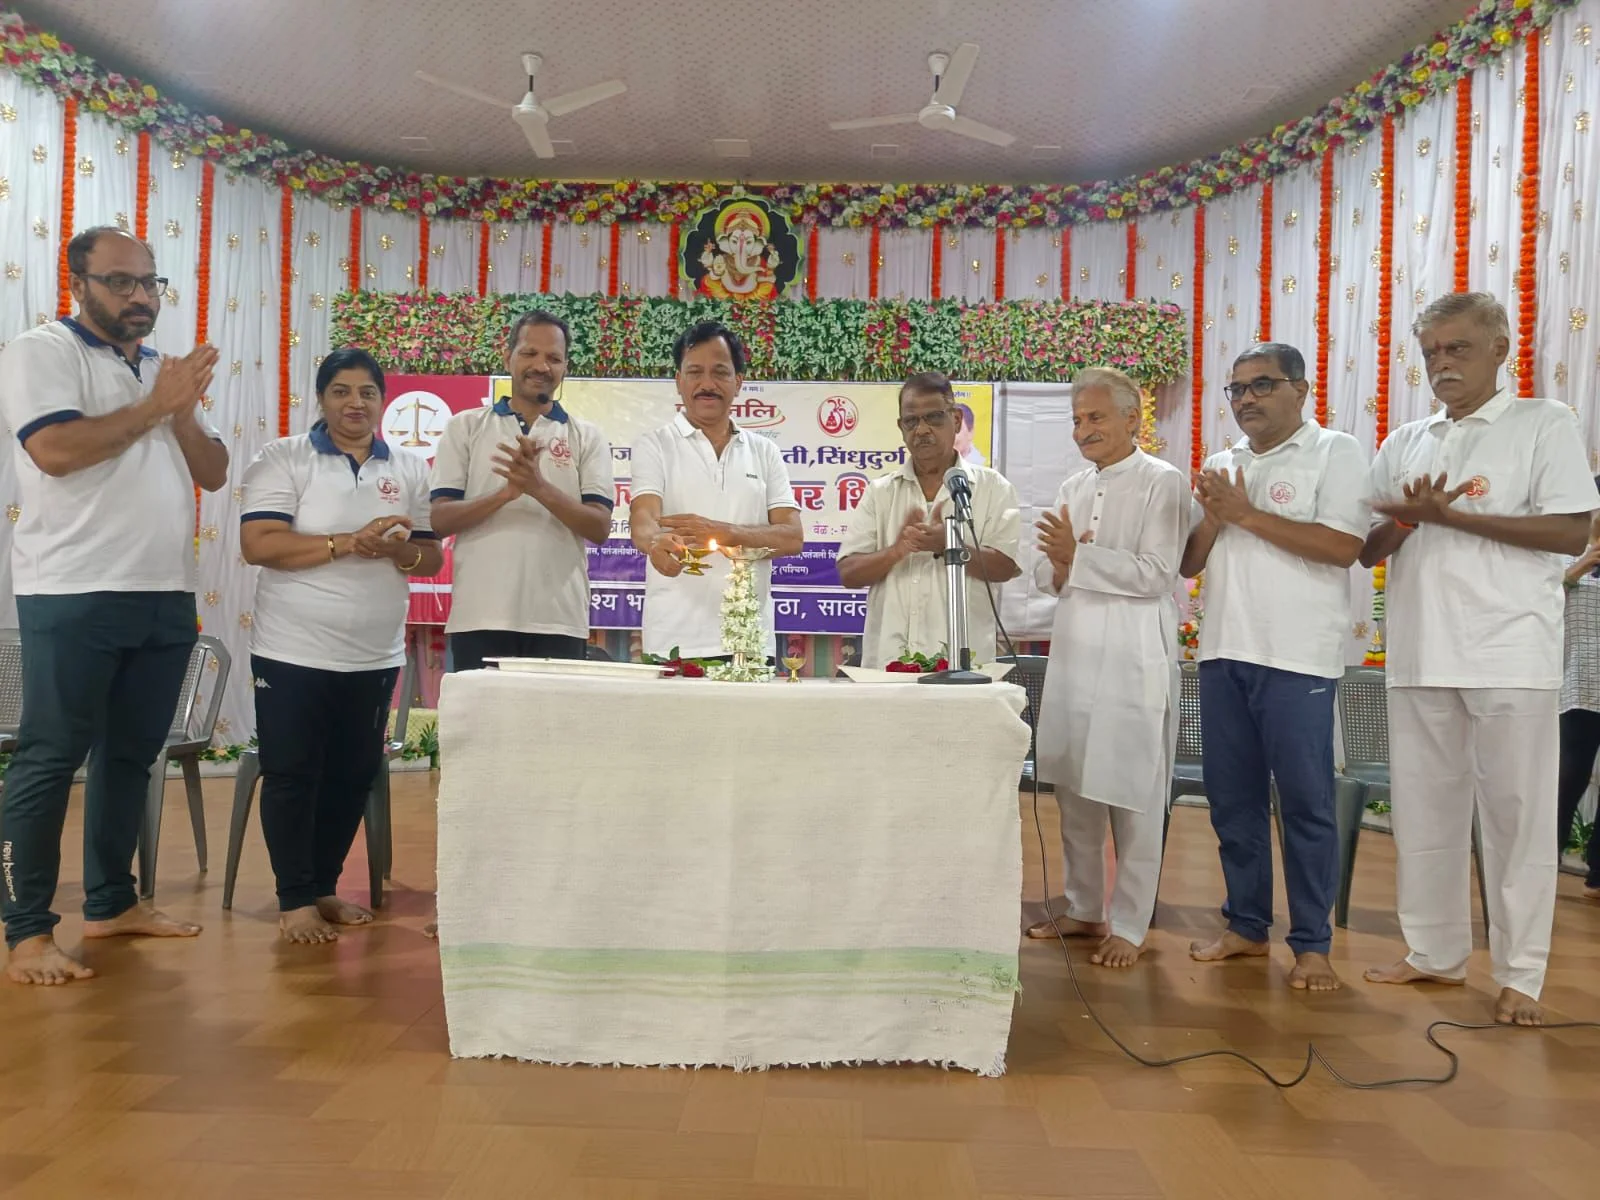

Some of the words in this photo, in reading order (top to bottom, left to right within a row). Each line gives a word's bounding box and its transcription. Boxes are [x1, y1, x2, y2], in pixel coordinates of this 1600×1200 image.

[780, 446, 905, 469] ती,सिंधुदुर्ग
[591, 593, 619, 611] श्य
[626, 593, 645, 612] भ
[774, 598, 807, 619] ठा,
[817, 594, 867, 617] सावंत
